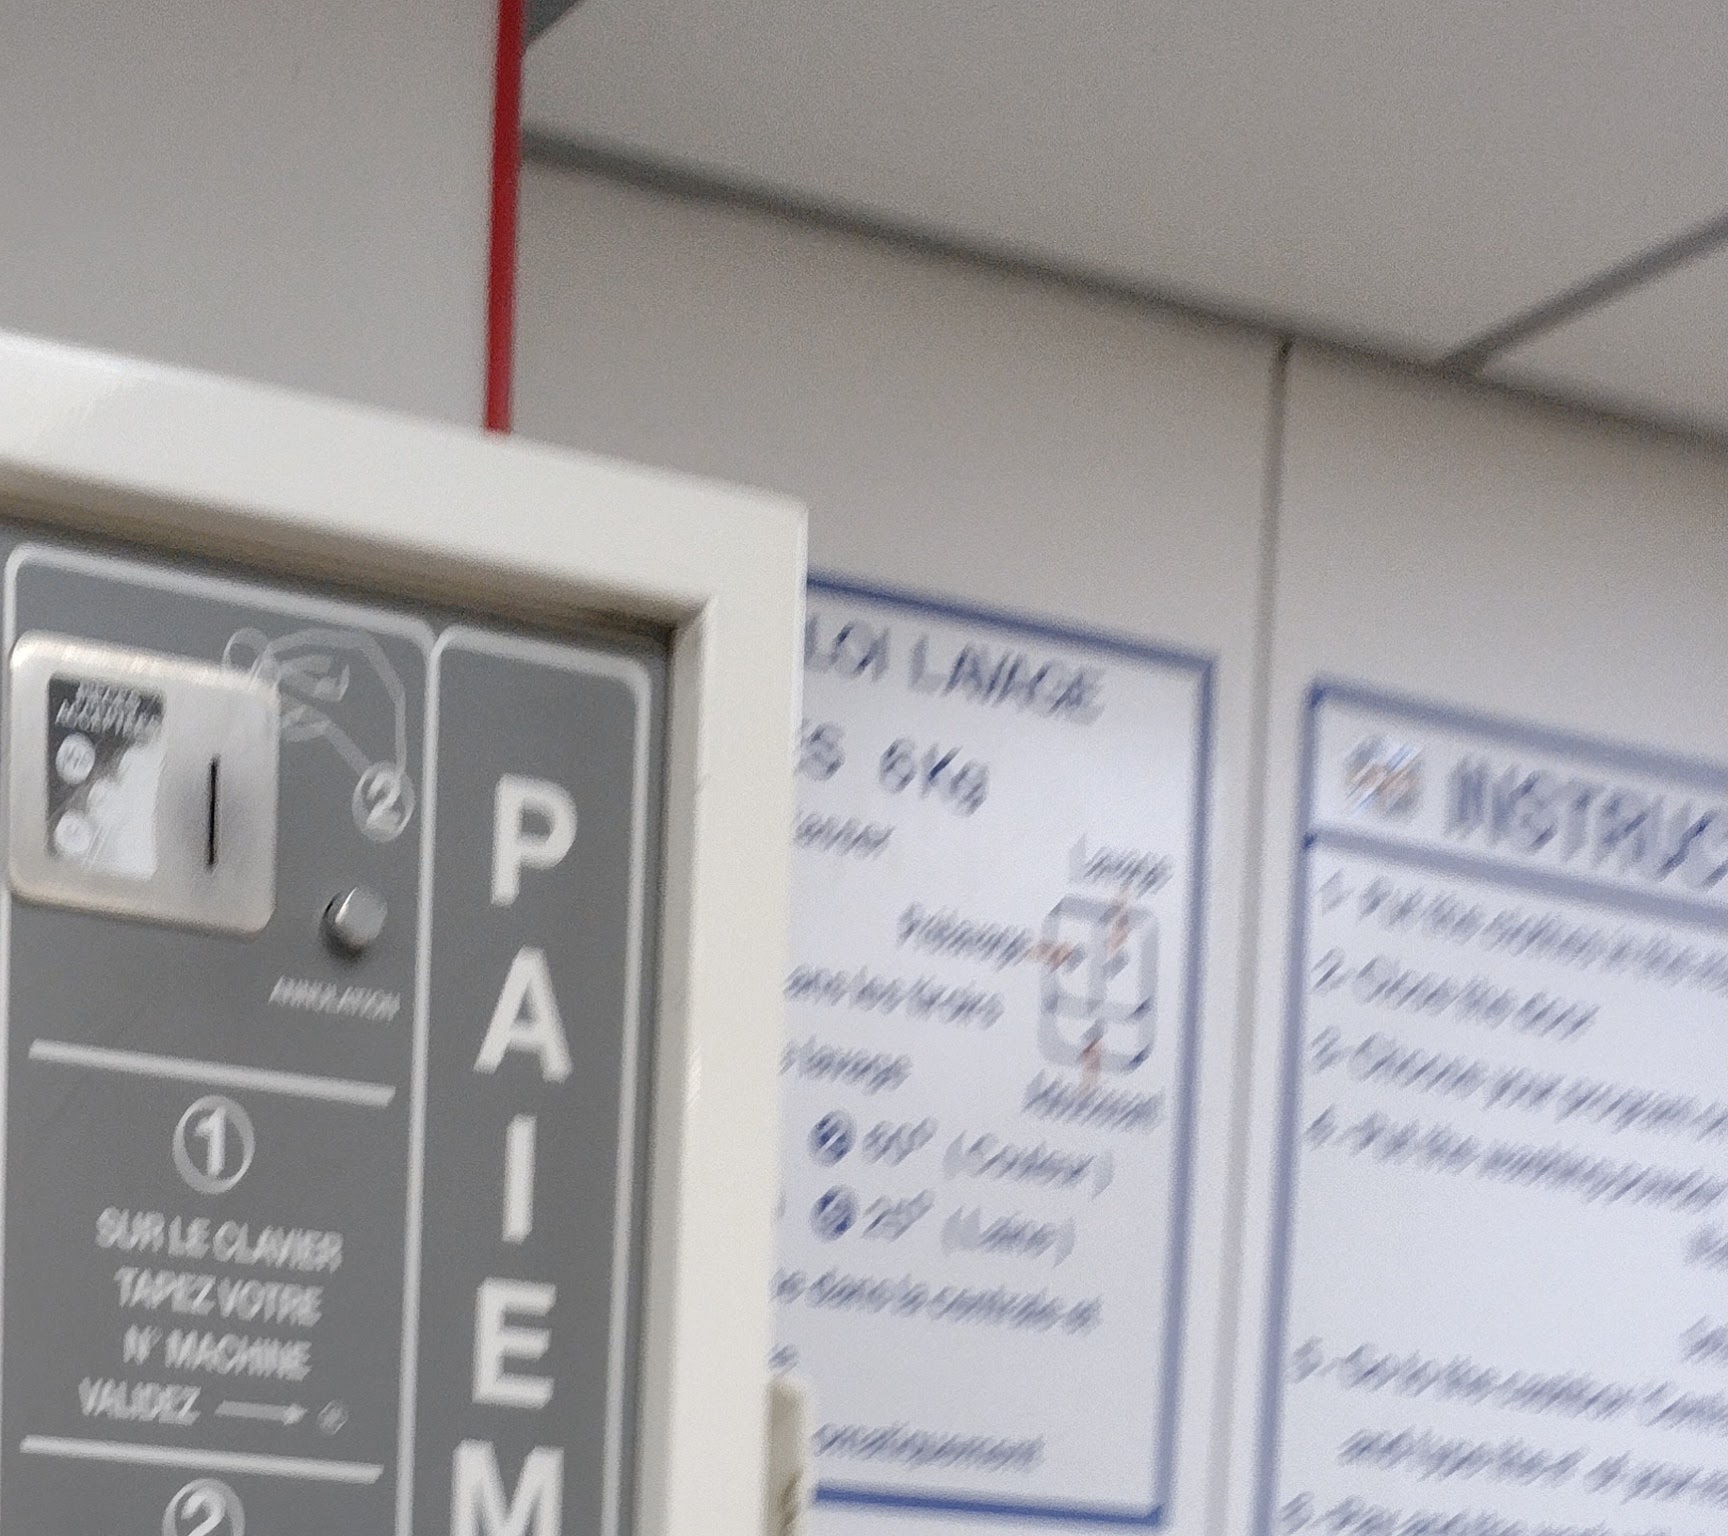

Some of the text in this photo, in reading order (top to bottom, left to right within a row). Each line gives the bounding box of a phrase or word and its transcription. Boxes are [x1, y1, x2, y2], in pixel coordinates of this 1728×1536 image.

[95, 1205, 345, 1274] SUR LE CLAVIER
[113, 1265, 325, 1328] TAPEZ VOTRE
[164, 1328, 313, 1382] MACHINE
[77, 1376, 202, 1427] VALIDEZ
